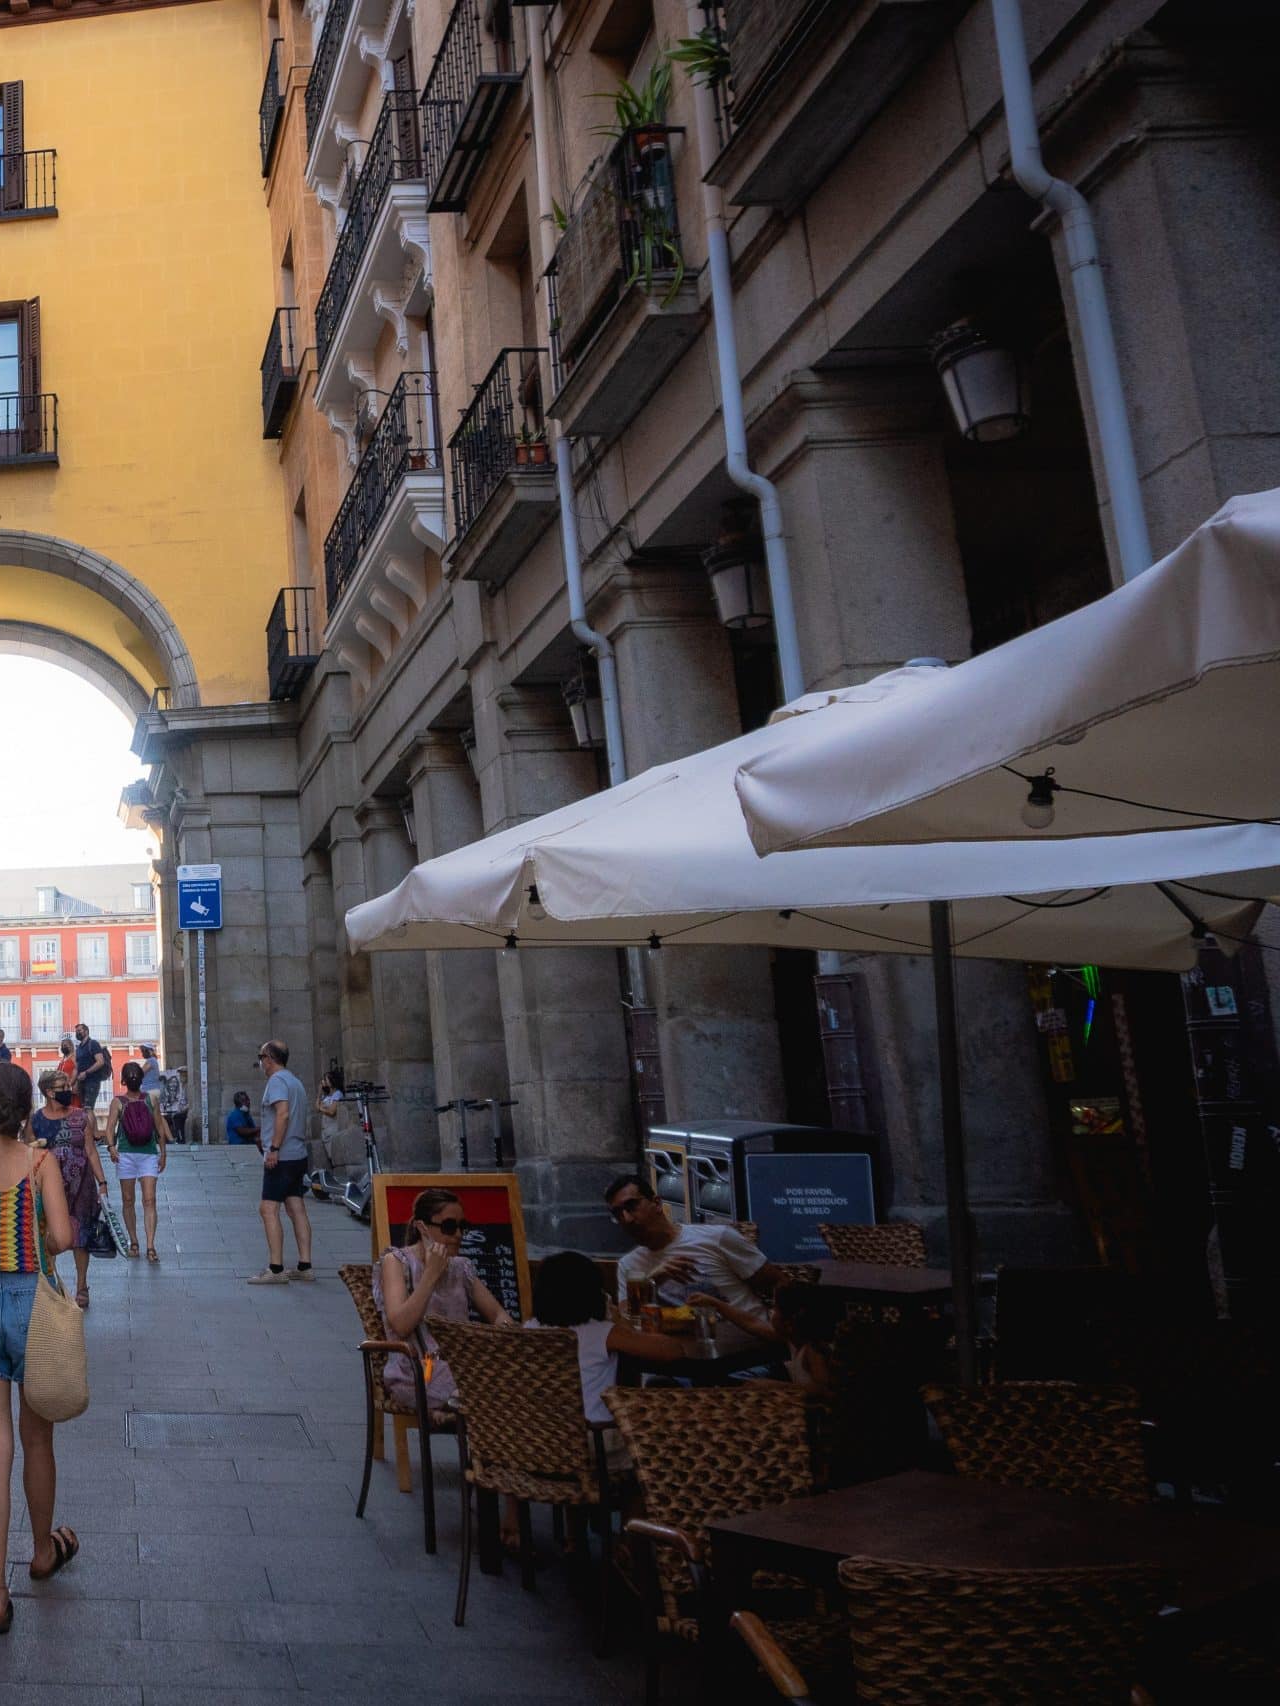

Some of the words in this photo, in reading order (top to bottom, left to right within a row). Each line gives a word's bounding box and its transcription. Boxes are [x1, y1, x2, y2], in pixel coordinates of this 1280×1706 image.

[786, 1188, 803, 1196] POR
[773, 1197, 787, 1206] NO
[788, 1197, 805, 1206] TIRE
[807, 1197, 848, 1206] RESIDUOS
[792, 1207, 802, 1215] AL
[803, 1207, 831, 1215] SUELO
